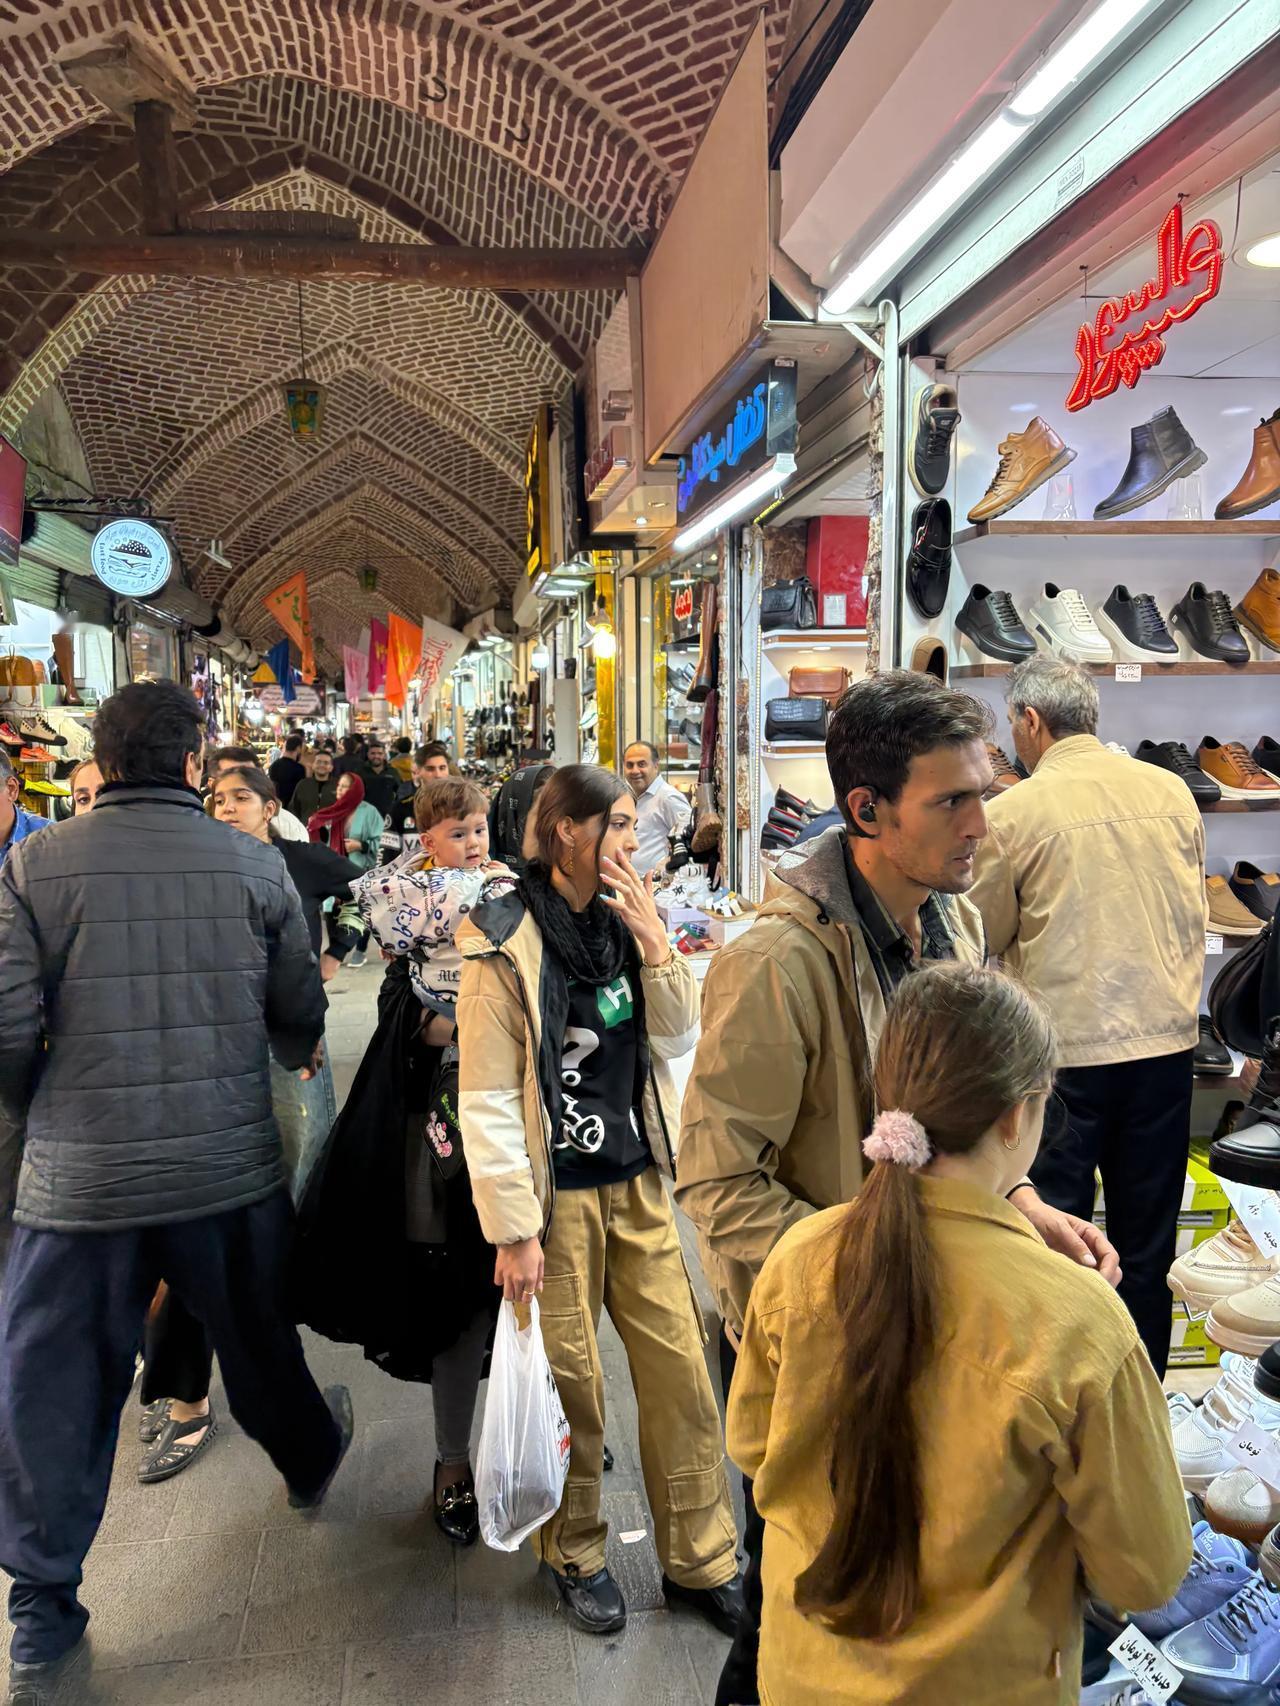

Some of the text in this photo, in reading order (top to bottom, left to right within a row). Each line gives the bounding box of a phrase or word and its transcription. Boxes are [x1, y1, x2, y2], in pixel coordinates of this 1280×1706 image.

[1263, 1231, 1278, 1249] جدید
[1238, 1441, 1262, 1457] تومان
[1119, 1639, 1146, 1661] تومان
[1151, 1672, 1171, 1694] جدید
